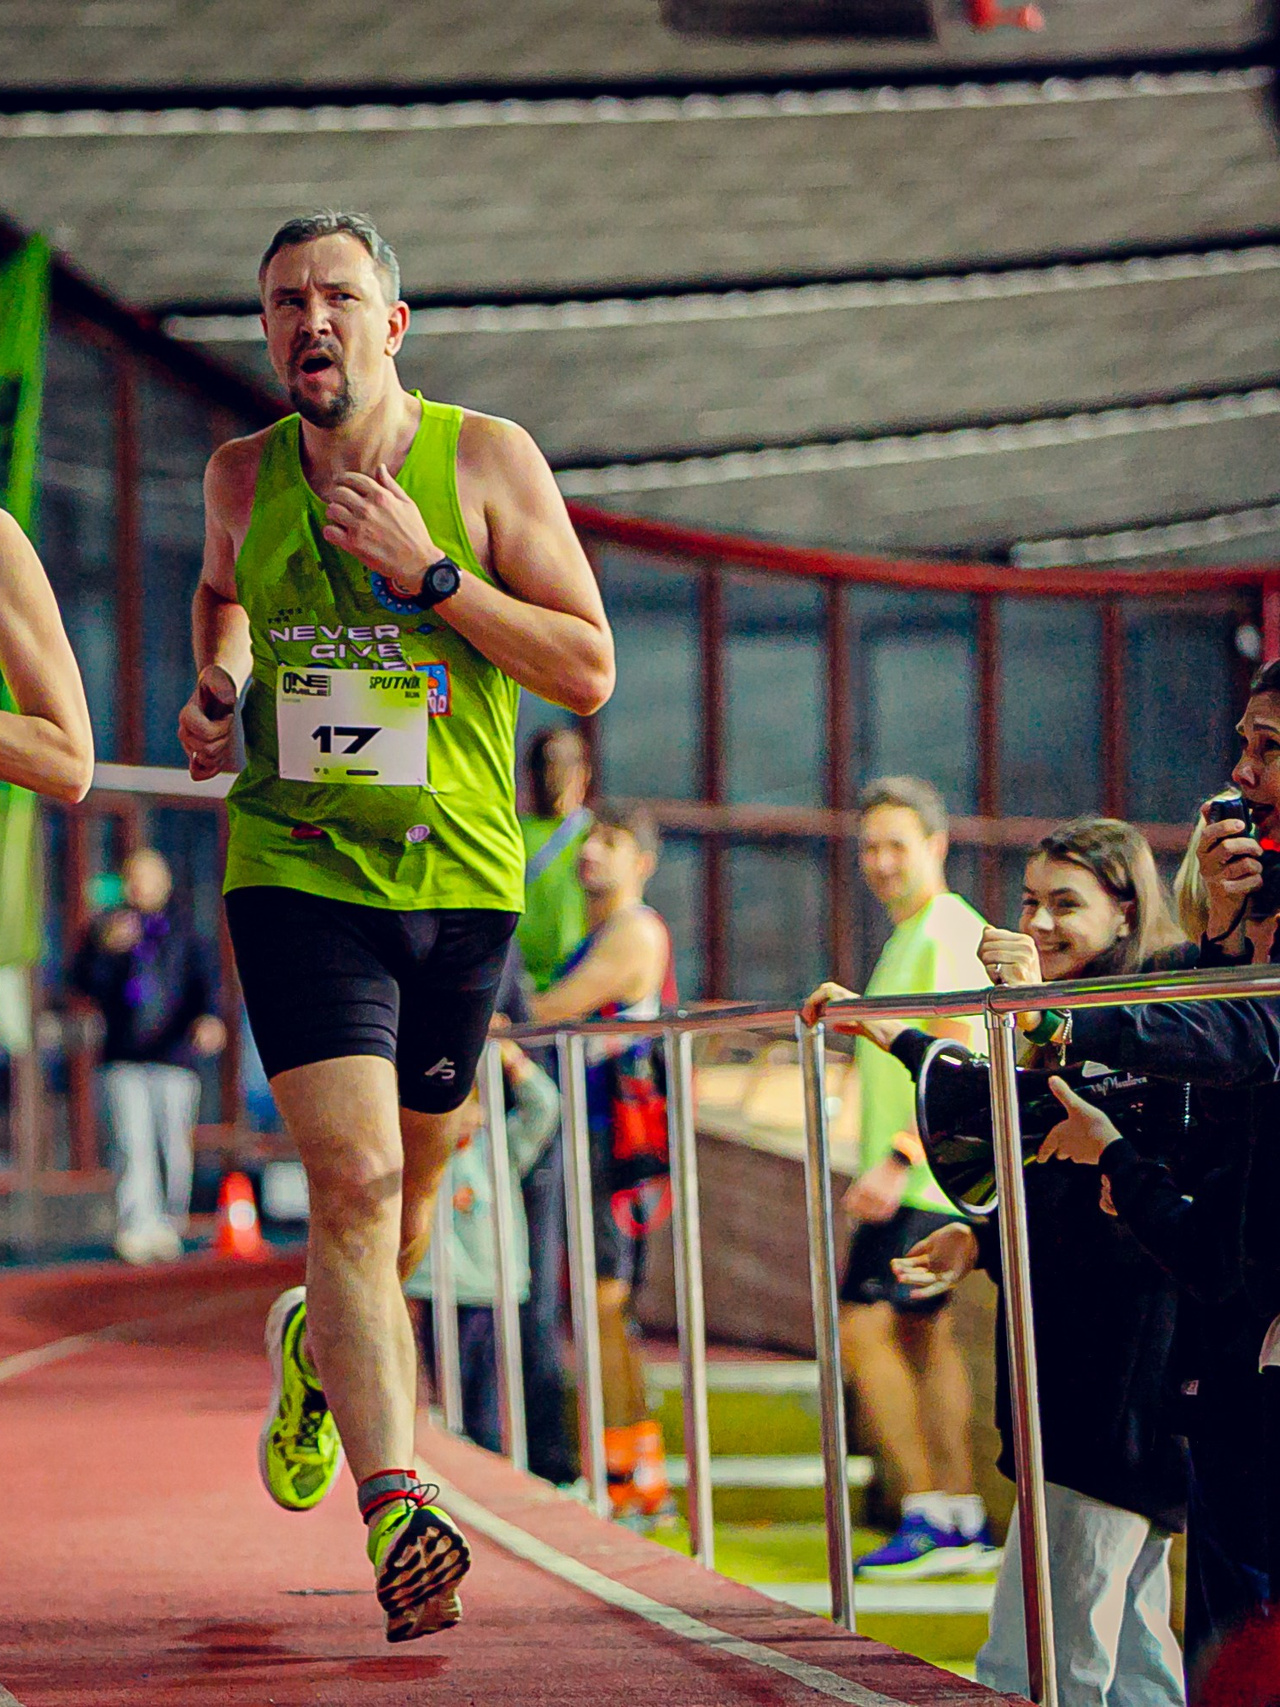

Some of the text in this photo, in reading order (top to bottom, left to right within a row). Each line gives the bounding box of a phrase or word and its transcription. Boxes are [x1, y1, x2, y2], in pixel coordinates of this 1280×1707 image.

[269, 624, 401, 643] NEVER
[310, 642, 403, 660] GIVE
[282, 672, 329, 694] ONE
[311, 725, 383, 754] 17
